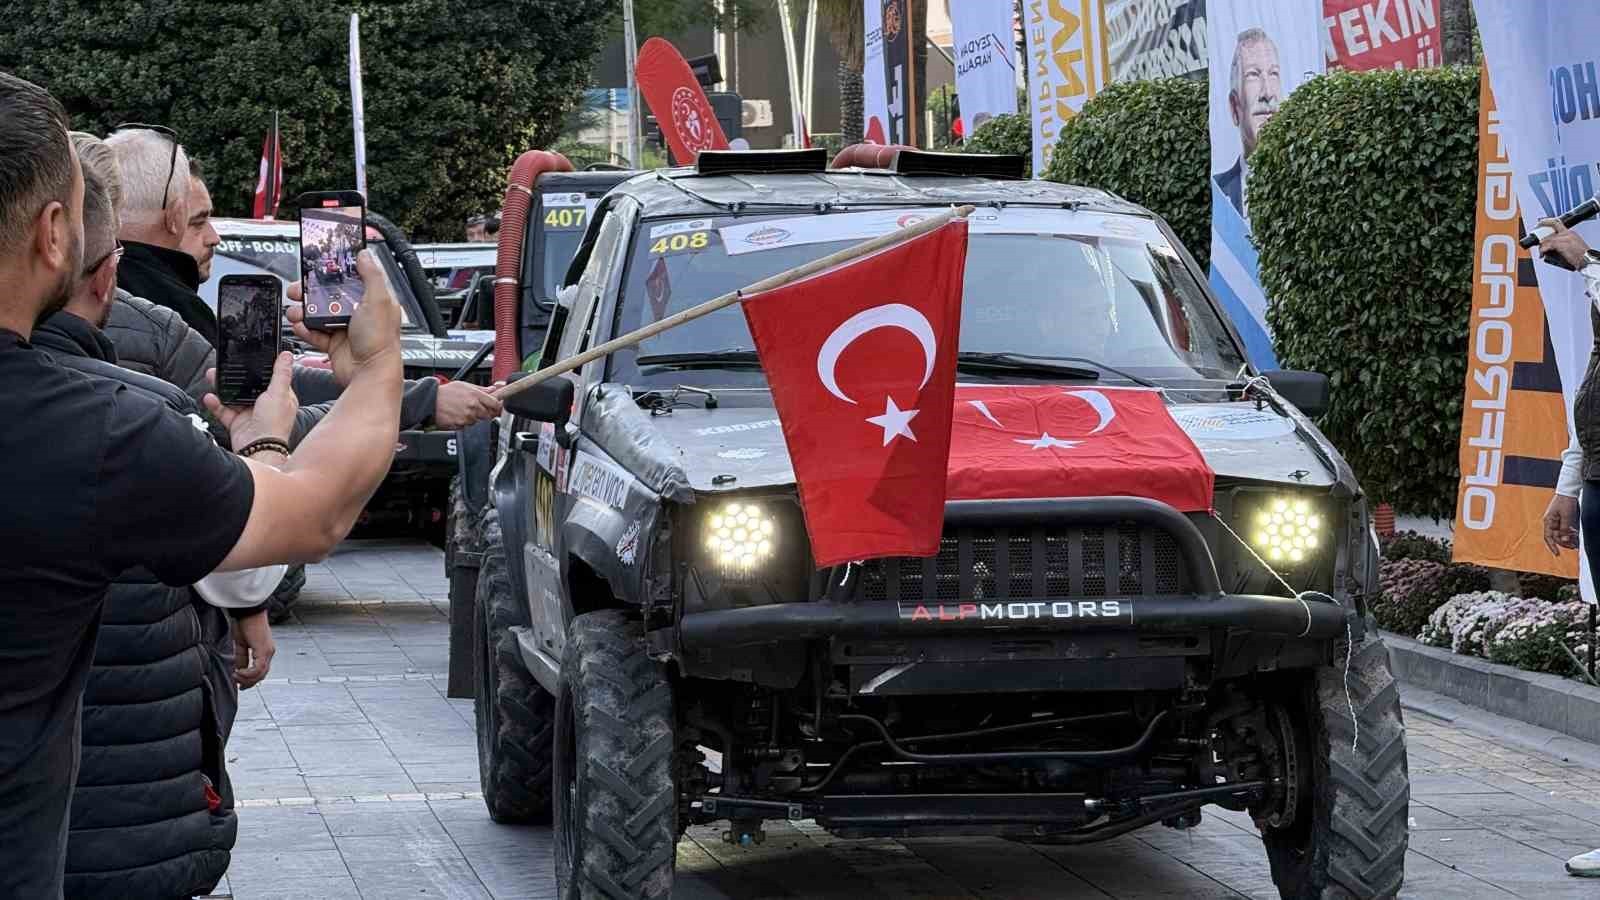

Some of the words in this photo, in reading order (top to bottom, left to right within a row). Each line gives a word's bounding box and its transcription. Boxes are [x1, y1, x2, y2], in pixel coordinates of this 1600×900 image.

[544, 209, 586, 228] 407
[650, 232, 709, 254] 408
[912, 601, 1121, 621] ALPMOTORS
